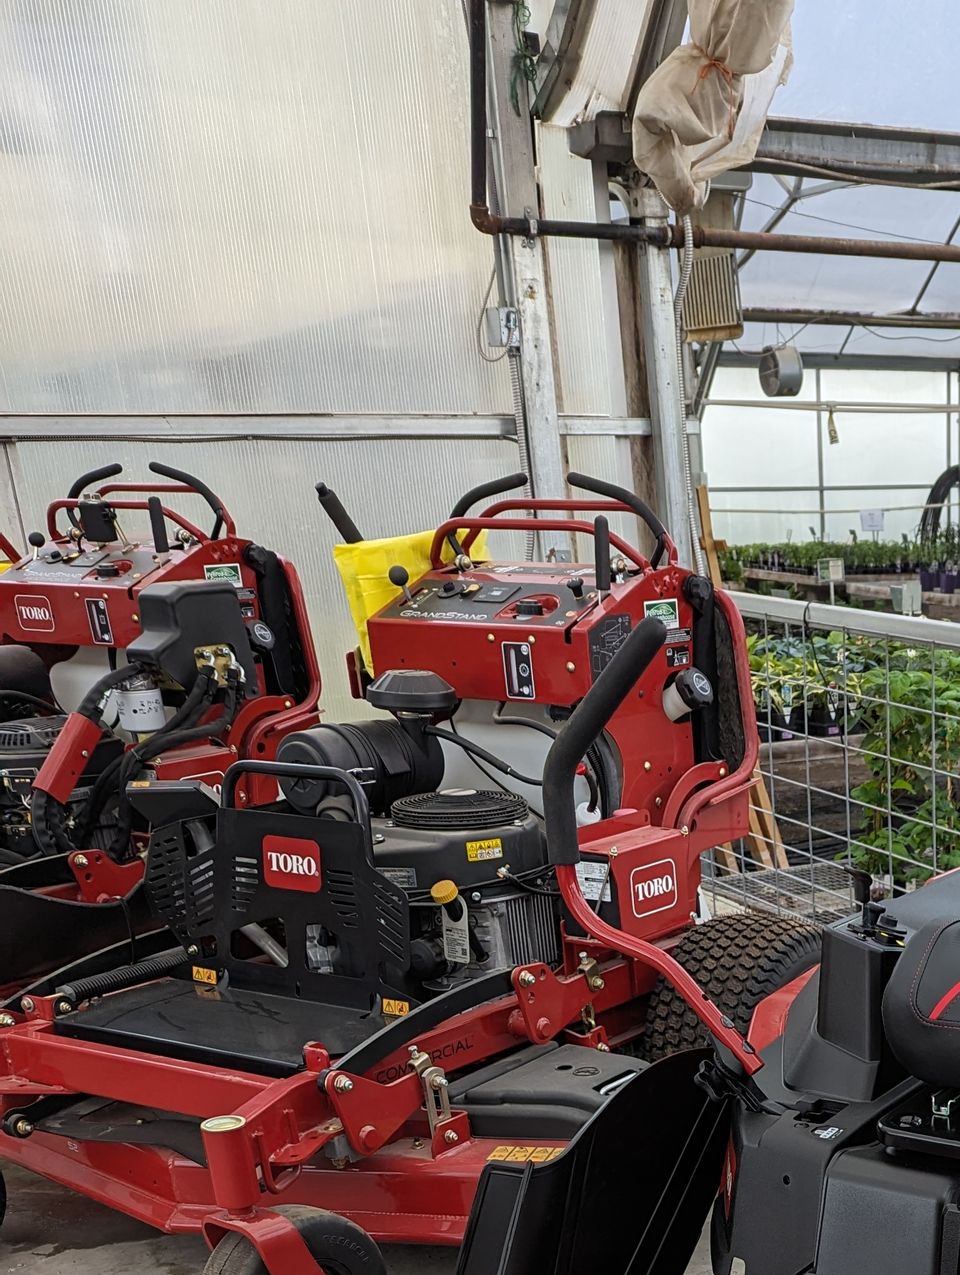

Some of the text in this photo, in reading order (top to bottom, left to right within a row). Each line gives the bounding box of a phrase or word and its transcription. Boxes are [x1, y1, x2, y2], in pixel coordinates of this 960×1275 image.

[19, 605, 49, 621] TORO
[267, 851, 318, 876] TORO
[635, 875, 674, 901] TORO
[376, 1038, 474, 1083] COMRCIAL
